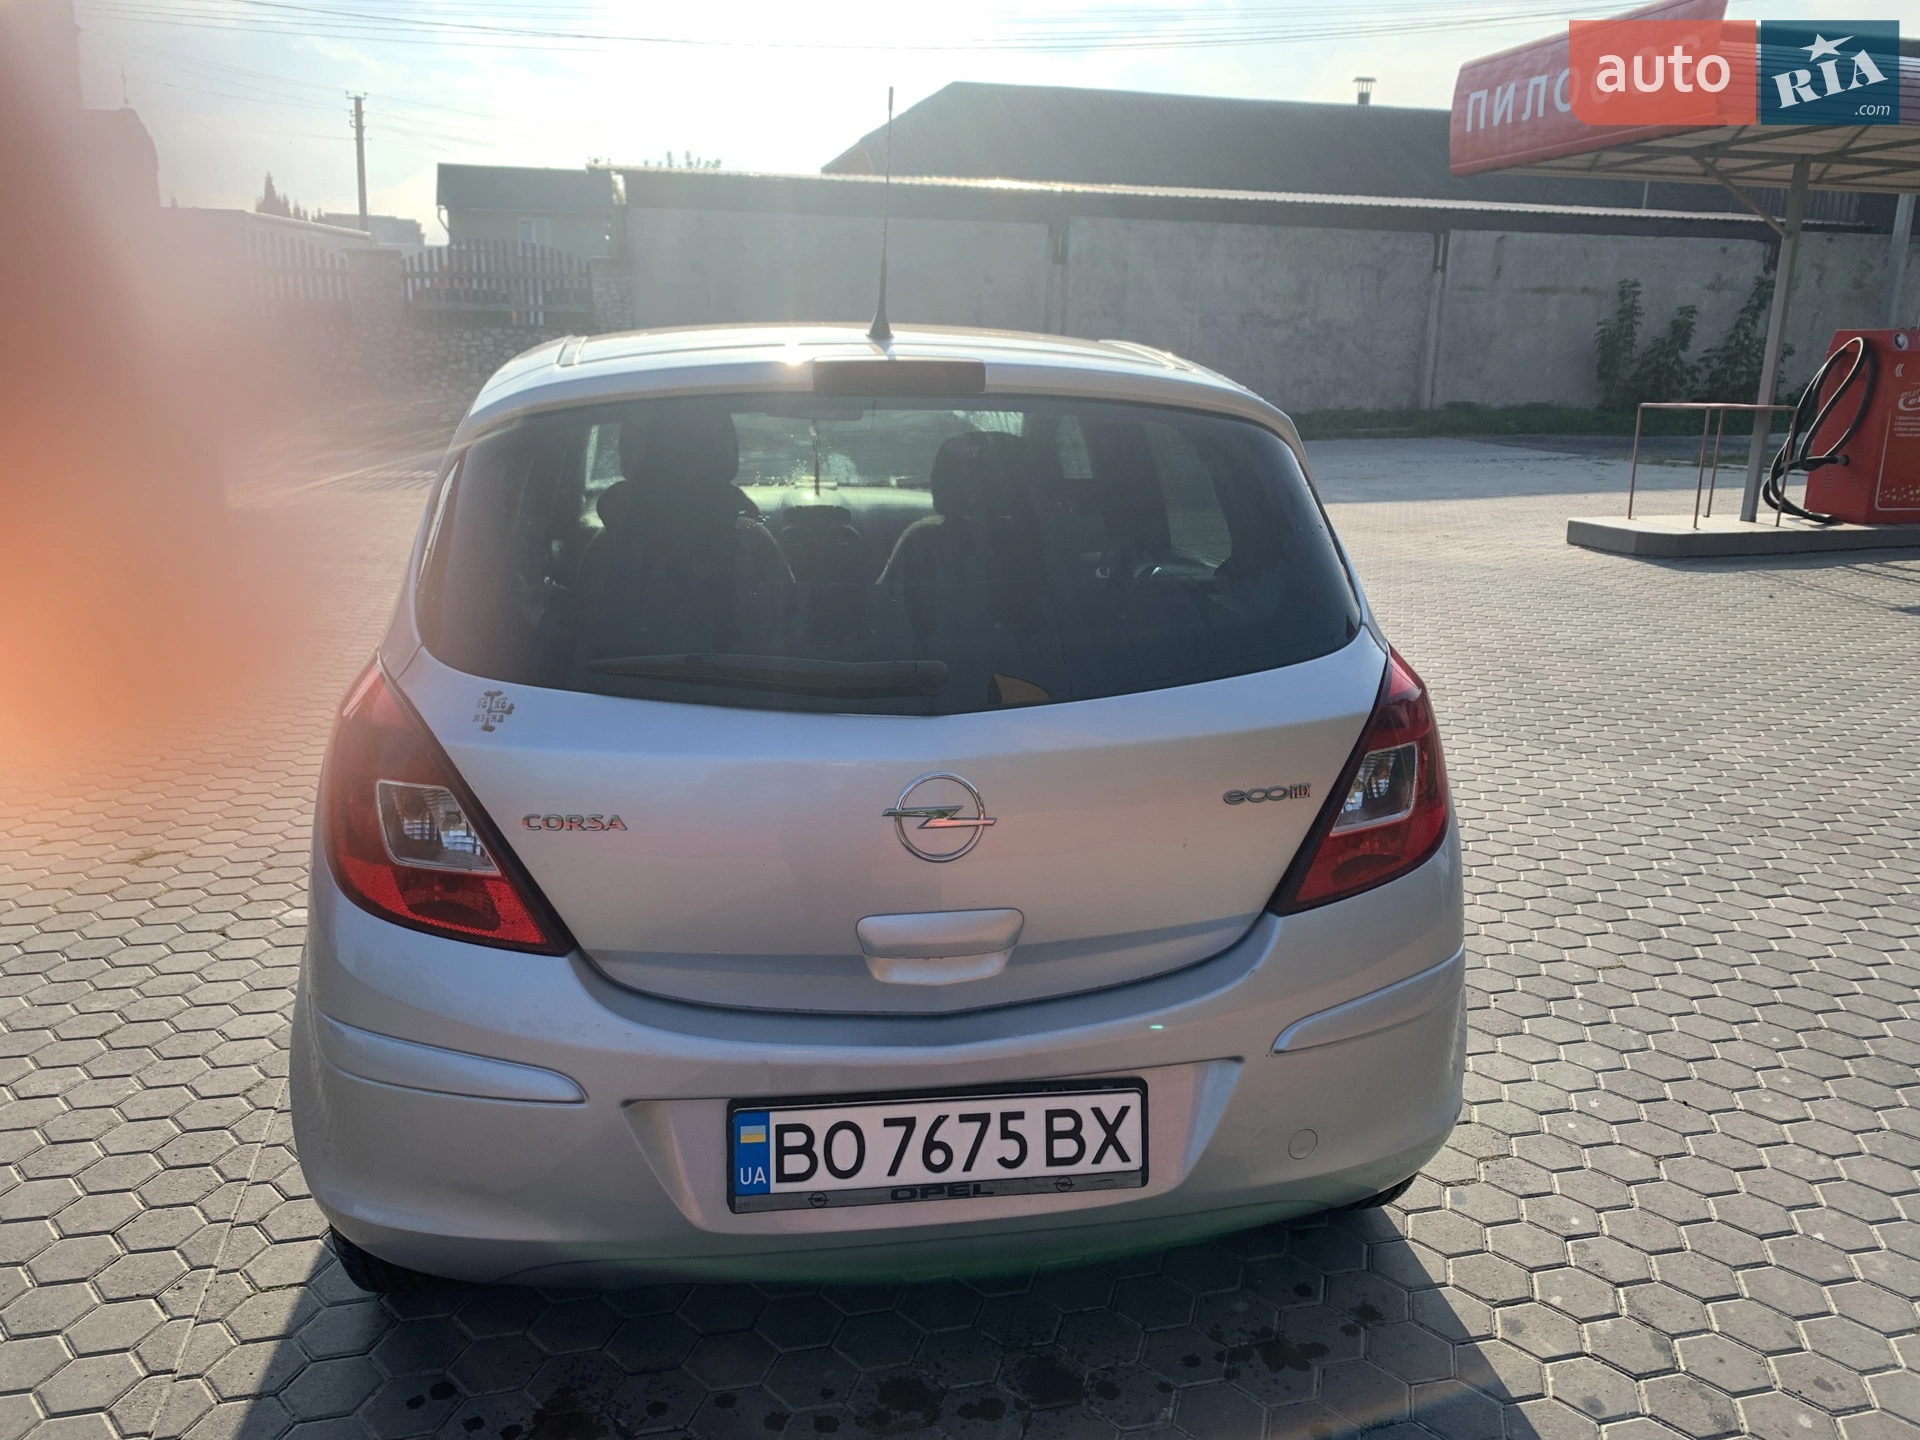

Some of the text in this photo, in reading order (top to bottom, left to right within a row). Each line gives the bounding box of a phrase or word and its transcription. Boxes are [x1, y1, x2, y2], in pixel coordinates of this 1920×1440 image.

[522, 813, 628, 832] CORSA
[775, 1105, 1132, 1184] BO 7675 BX
[740, 1166, 767, 1186] UA
[890, 1183, 995, 1202] OPEL
